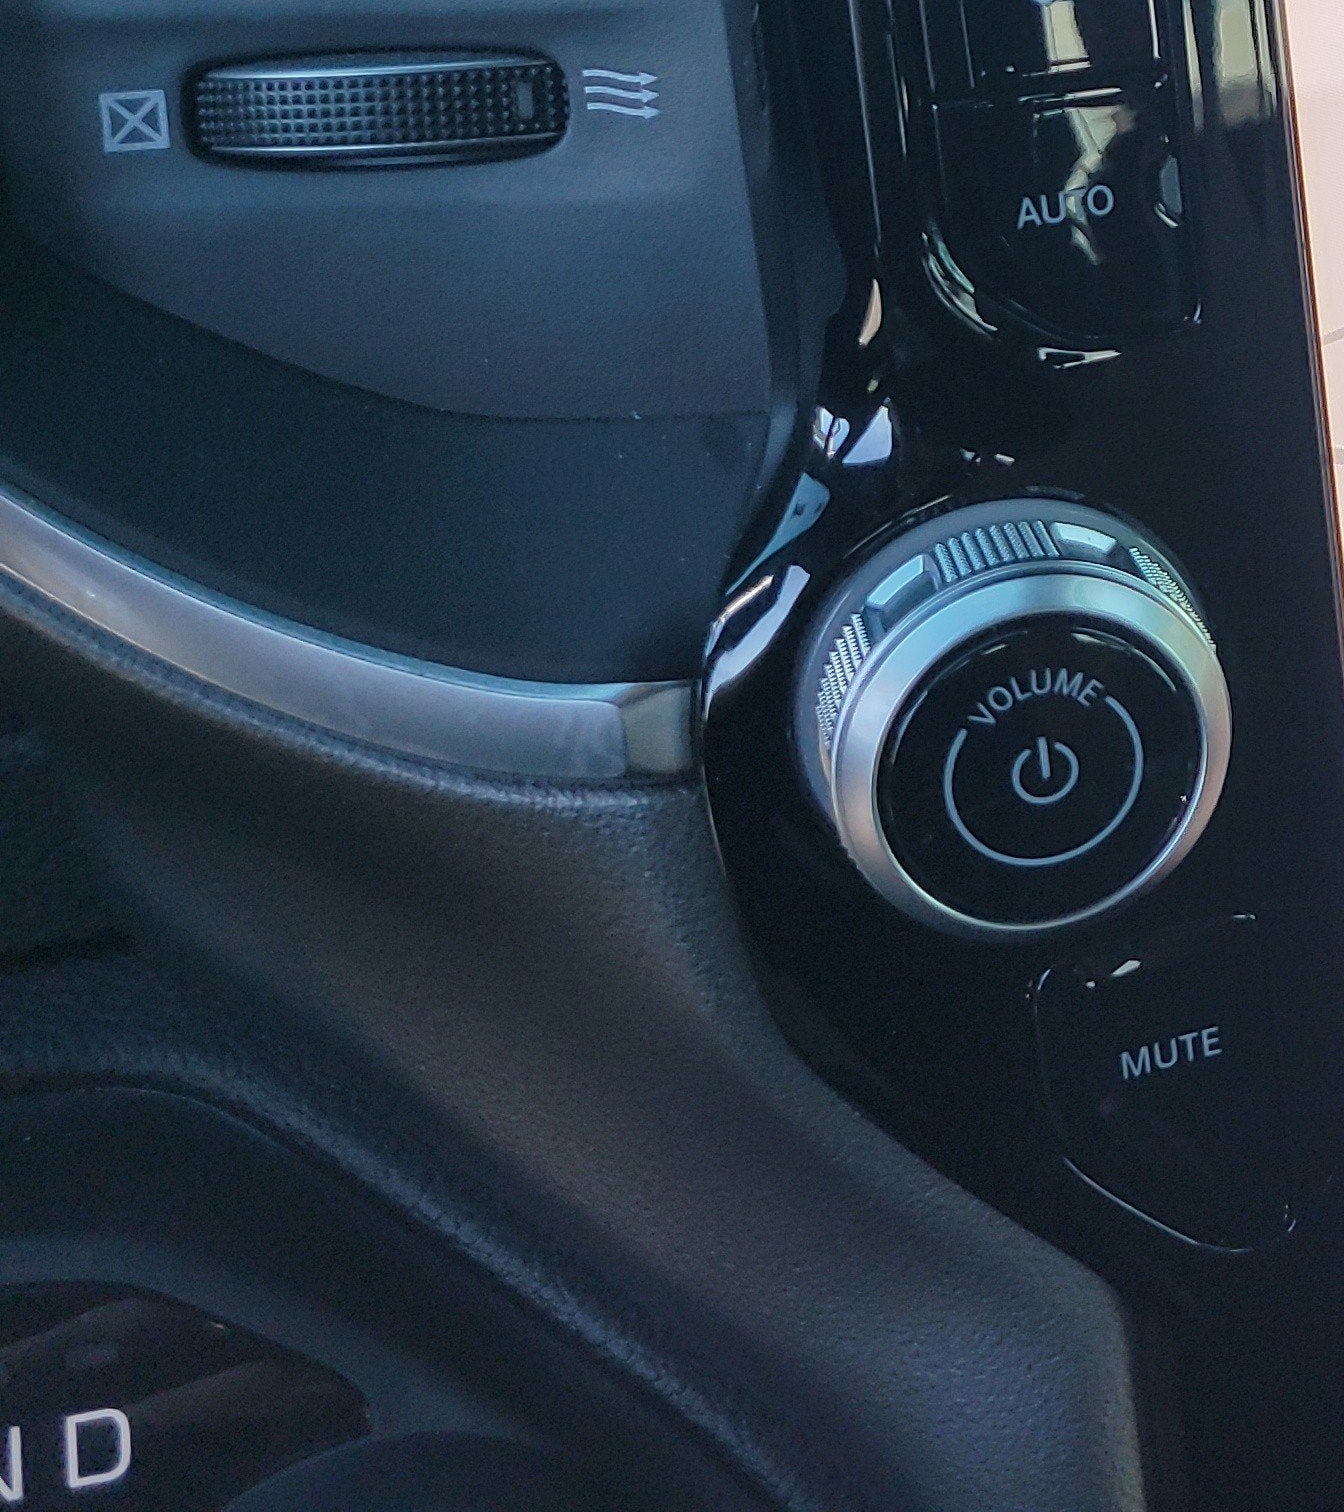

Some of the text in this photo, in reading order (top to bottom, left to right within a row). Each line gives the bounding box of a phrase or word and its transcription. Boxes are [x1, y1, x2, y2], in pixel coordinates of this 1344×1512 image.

[1016, 184, 1115, 229] AUTO
[967, 667, 1108, 727] VOLUME
[1119, 1026, 1222, 1081] MUTE
[64, 1407, 133, 1491] D
